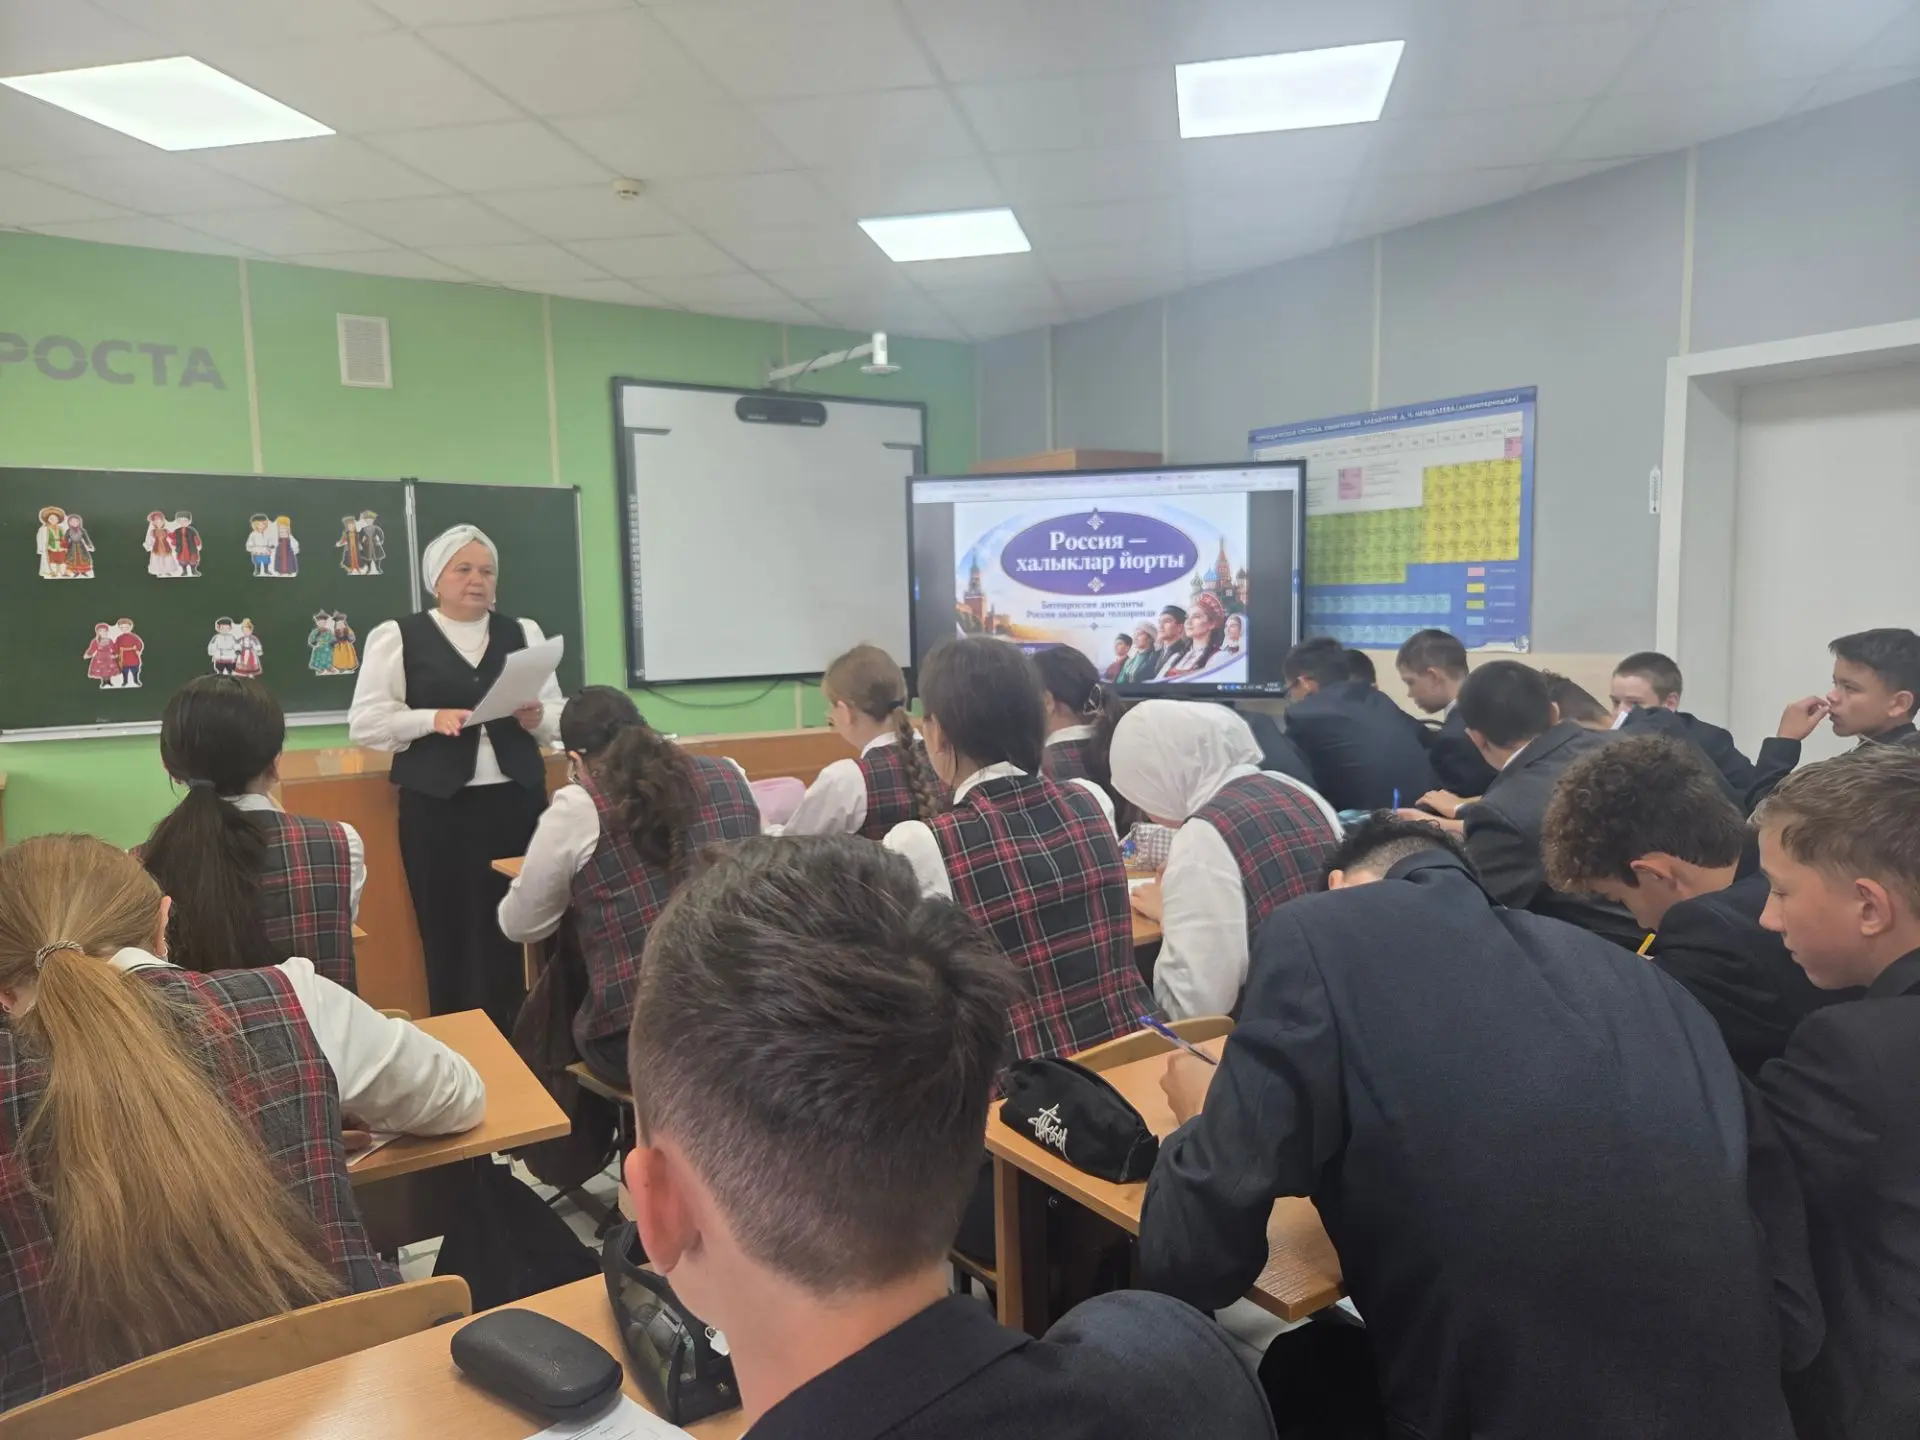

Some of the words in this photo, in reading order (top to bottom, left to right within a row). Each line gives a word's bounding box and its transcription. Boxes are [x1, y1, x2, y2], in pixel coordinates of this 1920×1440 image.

[0, 332, 227, 390] РОСТА
[1050, 532, 1124, 551] Россия
[1016, 555, 1115, 575] халыклар
[1119, 551, 1185, 574] йорты
